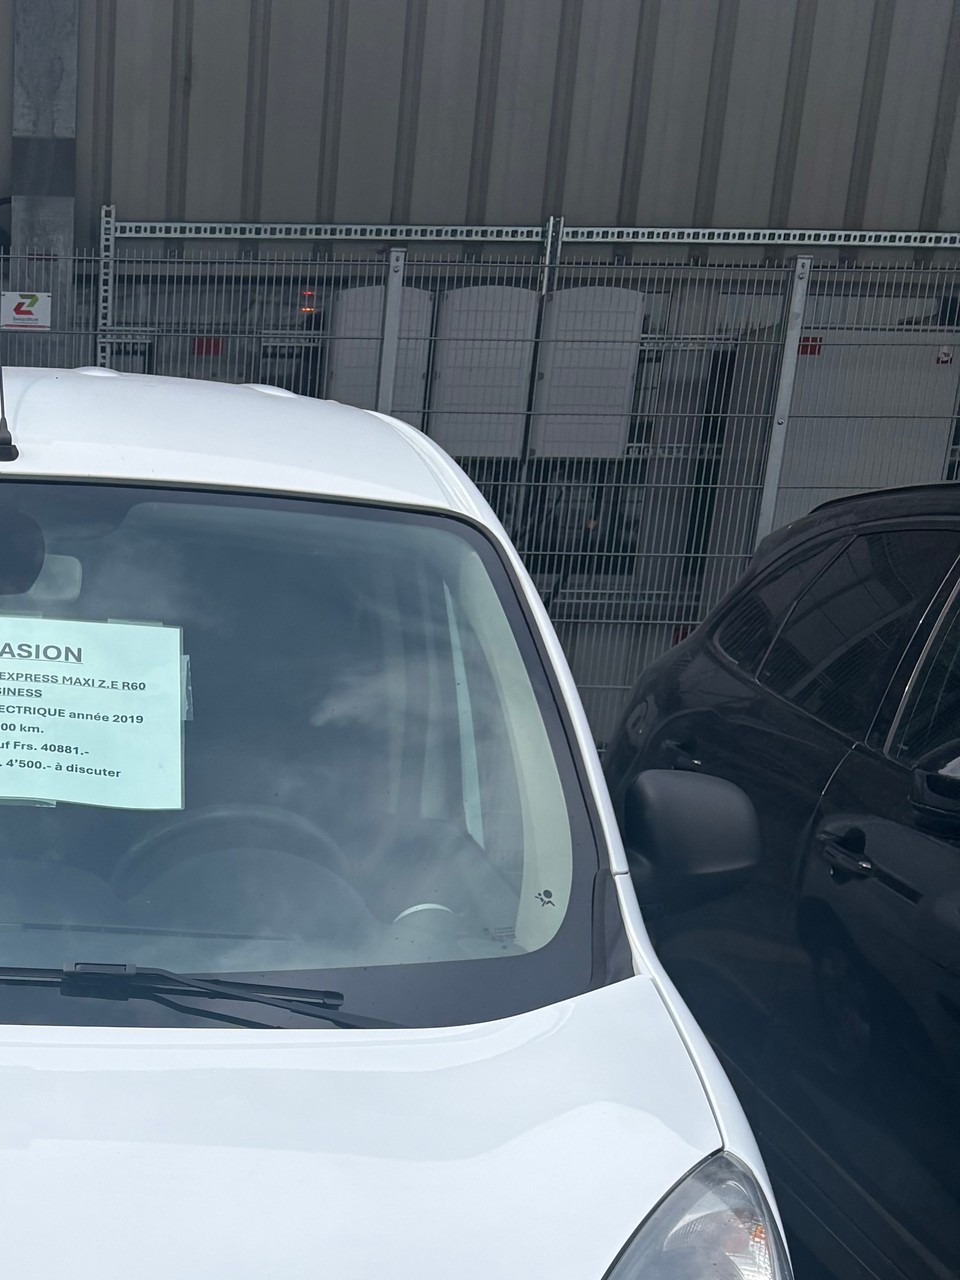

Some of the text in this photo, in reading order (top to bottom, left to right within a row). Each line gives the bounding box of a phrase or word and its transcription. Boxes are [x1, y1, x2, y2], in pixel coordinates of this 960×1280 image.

[62, 675, 95, 688] MAXI
[97, 679, 119, 690] Z.E
[121, 681, 147, 691] R60
[68, 712, 110, 722] année
[112, 714, 144, 724] 2019
[19, 723, 44, 734] km.
[13, 741, 38, 751] Frs.
[40, 743, 90, 756] 40881.-
[54, 761, 63, 771] à
[65, 763, 122, 778] discuter
